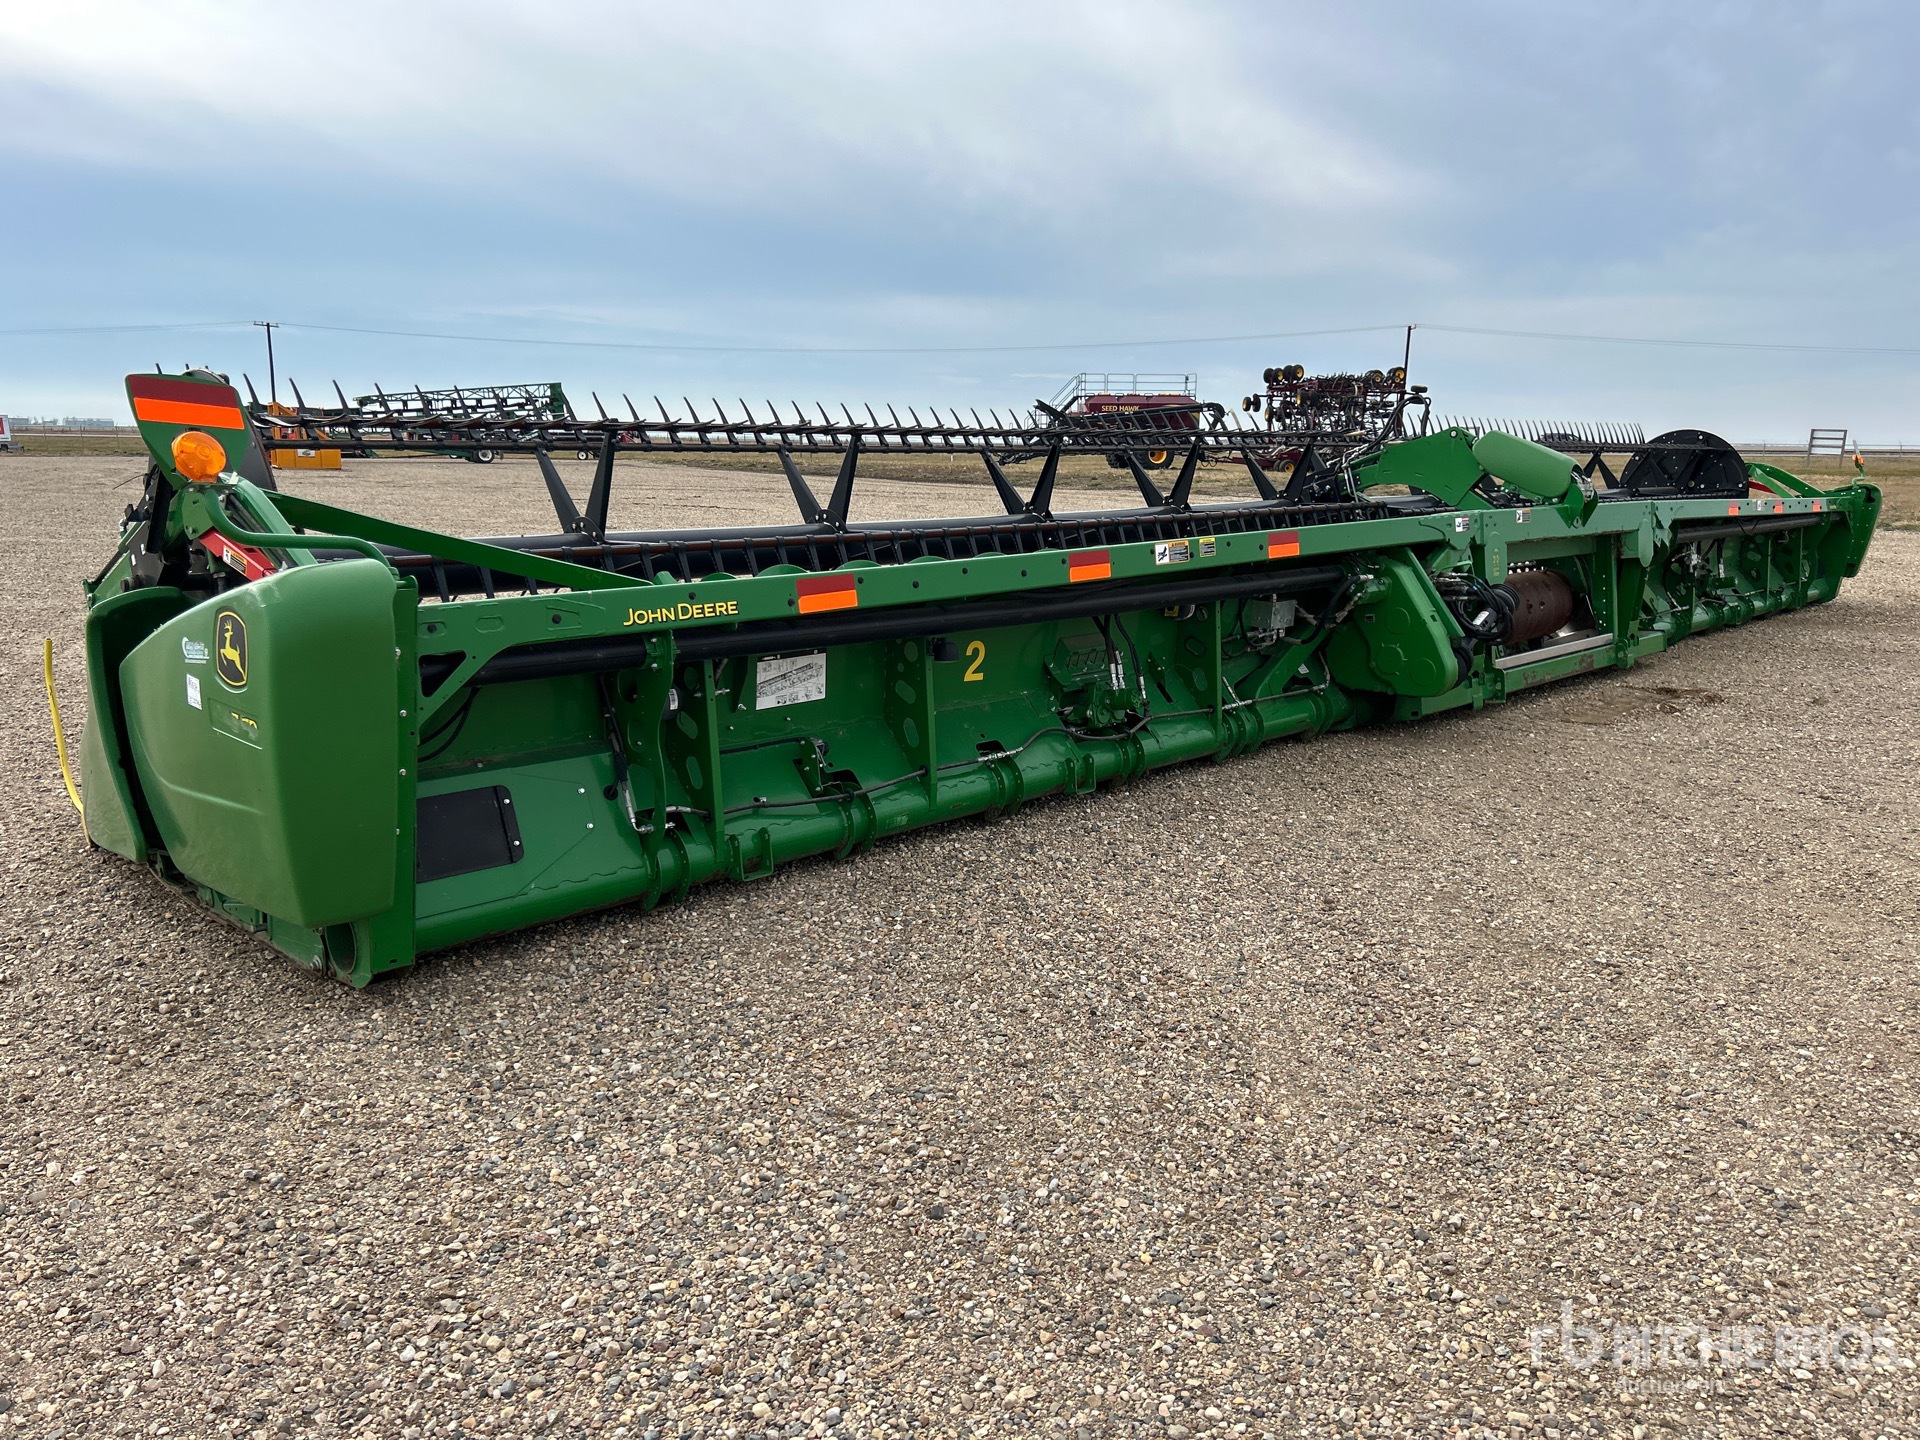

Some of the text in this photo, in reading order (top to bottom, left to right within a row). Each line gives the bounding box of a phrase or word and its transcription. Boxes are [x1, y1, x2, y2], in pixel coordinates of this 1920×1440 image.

[623, 601, 739, 626] JOHN DEERE
[964, 640, 986, 682] 2
